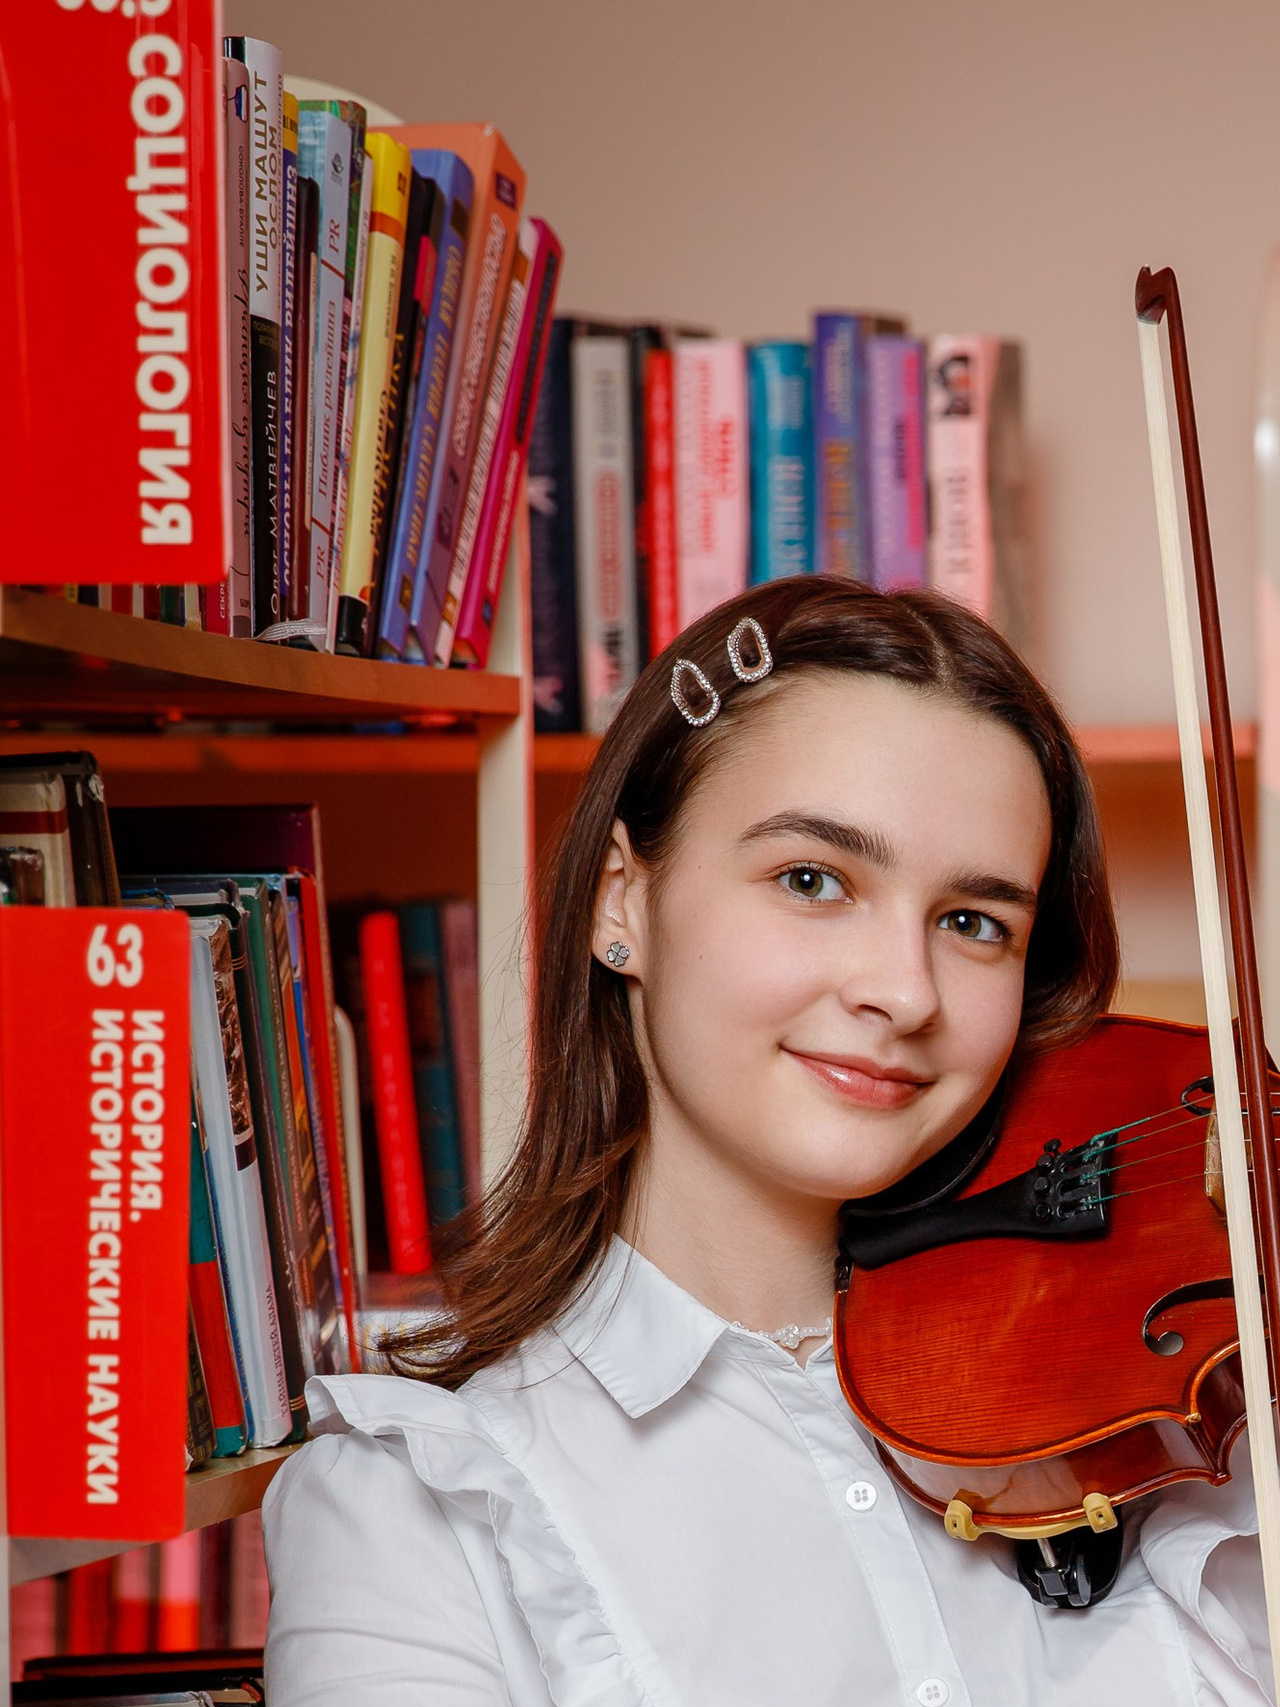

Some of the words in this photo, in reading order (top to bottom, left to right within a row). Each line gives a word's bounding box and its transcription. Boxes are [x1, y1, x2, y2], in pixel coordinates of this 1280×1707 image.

[254, 71, 267, 201] МАШУТ
[268, 126, 278, 249] ОСЛОМ
[254, 212, 268, 292] УШИ
[328, 218, 341, 254] PR
[127, 34, 192, 546] СОЦИОЛОГИЯ
[323, 300, 336, 410] рилейшнз
[265, 371, 278, 538] МАТВЕЙЧЕВ
[317, 416, 331, 498] Паблик
[315, 546, 326, 580] PR
[87, 924, 144, 988] 63
[129, 1008, 166, 1223] ИСТОРИЯ.
[88, 1008, 125, 1341] ИСТОРИЧЕСКИЕ
[264, 1282, 276, 1327] АДАМА
[269, 1327, 282, 1369] ДЕТЕЙ
[86, 1353, 121, 1506] НАУКИ
[275, 1369, 288, 1418] ТАЙНЫ
